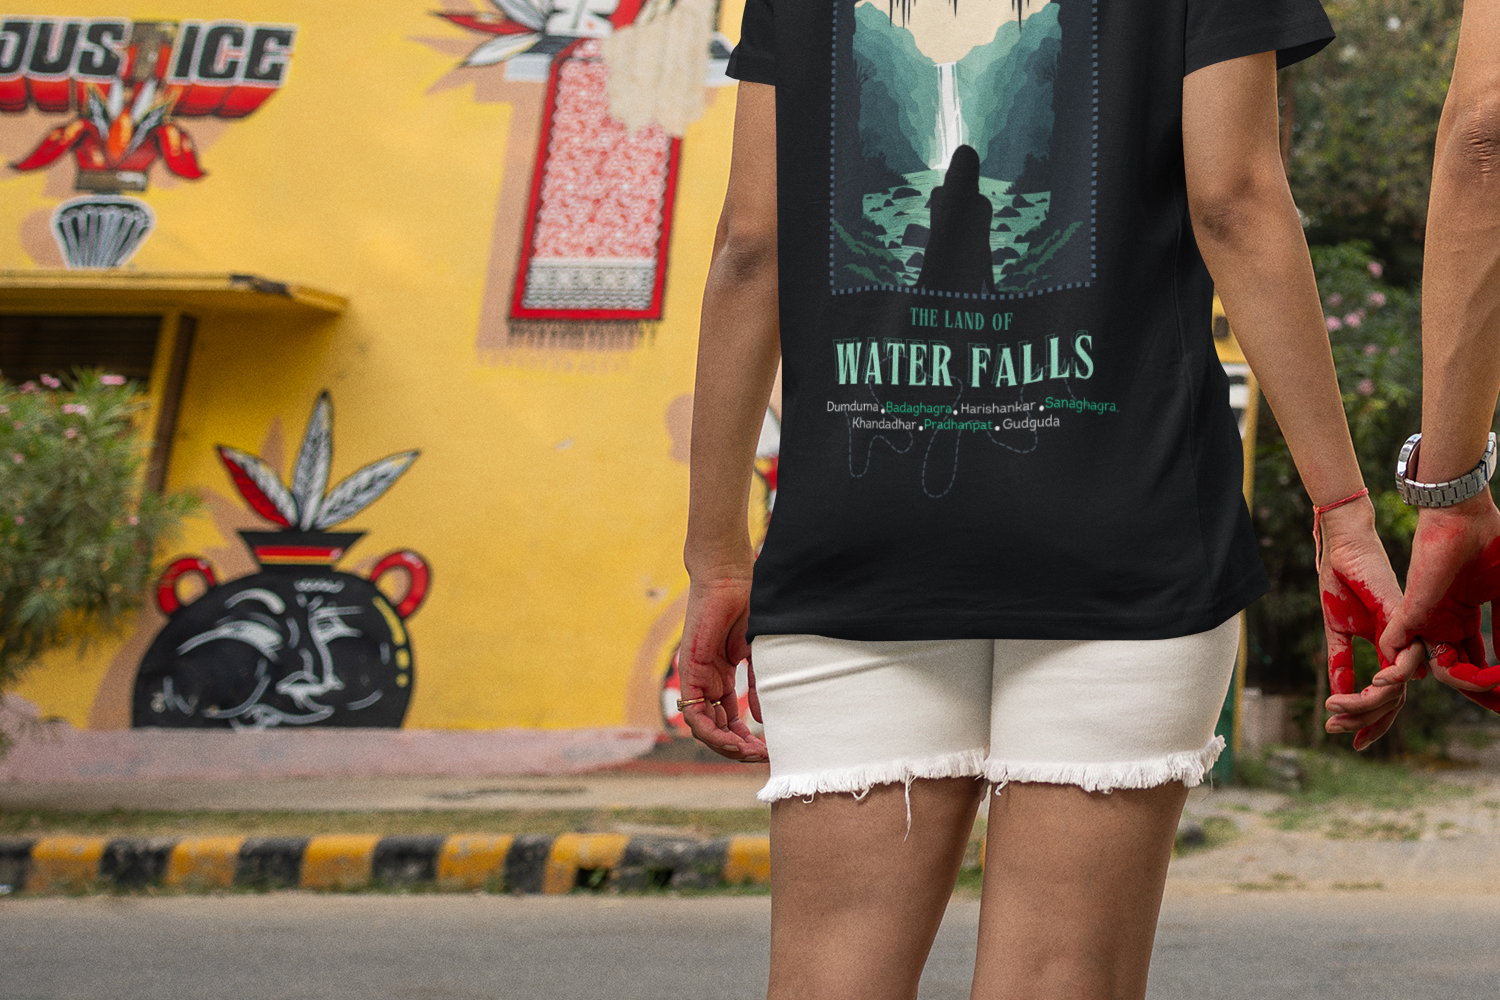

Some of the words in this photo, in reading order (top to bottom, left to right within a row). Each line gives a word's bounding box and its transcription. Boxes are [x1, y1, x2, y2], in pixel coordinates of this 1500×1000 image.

[910, 307, 938, 327] THE
[945, 310, 985, 330] LAND
[992, 312, 1014, 331] OF
[836, 341, 953, 387] WATER
[970, 334, 1094, 388] FALLS
[826, 400, 879, 412] Dumduma
[885, 401, 953, 417] Badaghagra
[960, 401, 1036, 415] Harishankar
[1045, 396, 1117, 415] Sanaghagra
[852, 417, 917, 430] Khandadhar
[924, 418, 993, 433] Pradhanpat
[1002, 414, 1060, 431] Gudguda
